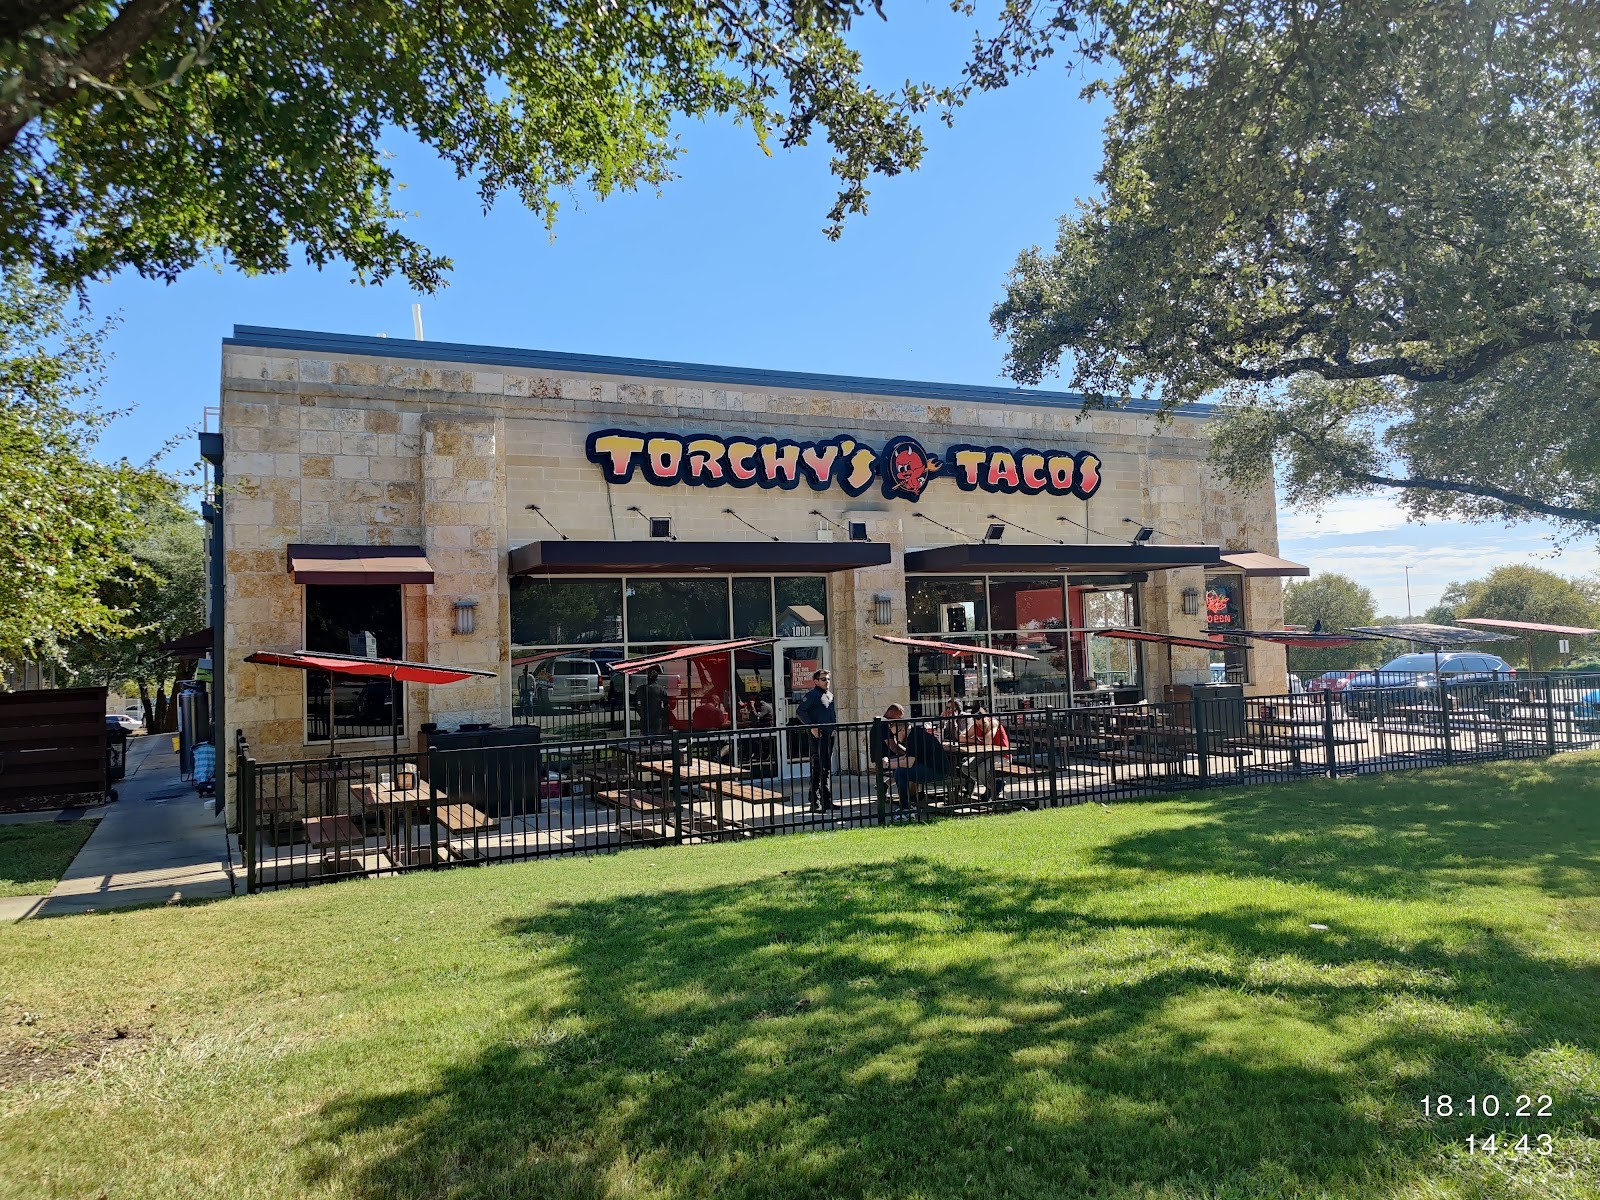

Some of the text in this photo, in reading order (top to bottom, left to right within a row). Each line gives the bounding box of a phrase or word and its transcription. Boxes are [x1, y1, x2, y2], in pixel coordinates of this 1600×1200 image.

[595, 435, 1100, 493] TORCHY'S TACOS
[1206, 614, 1231, 623] OPEN
[792, 626, 811, 637] 1000
